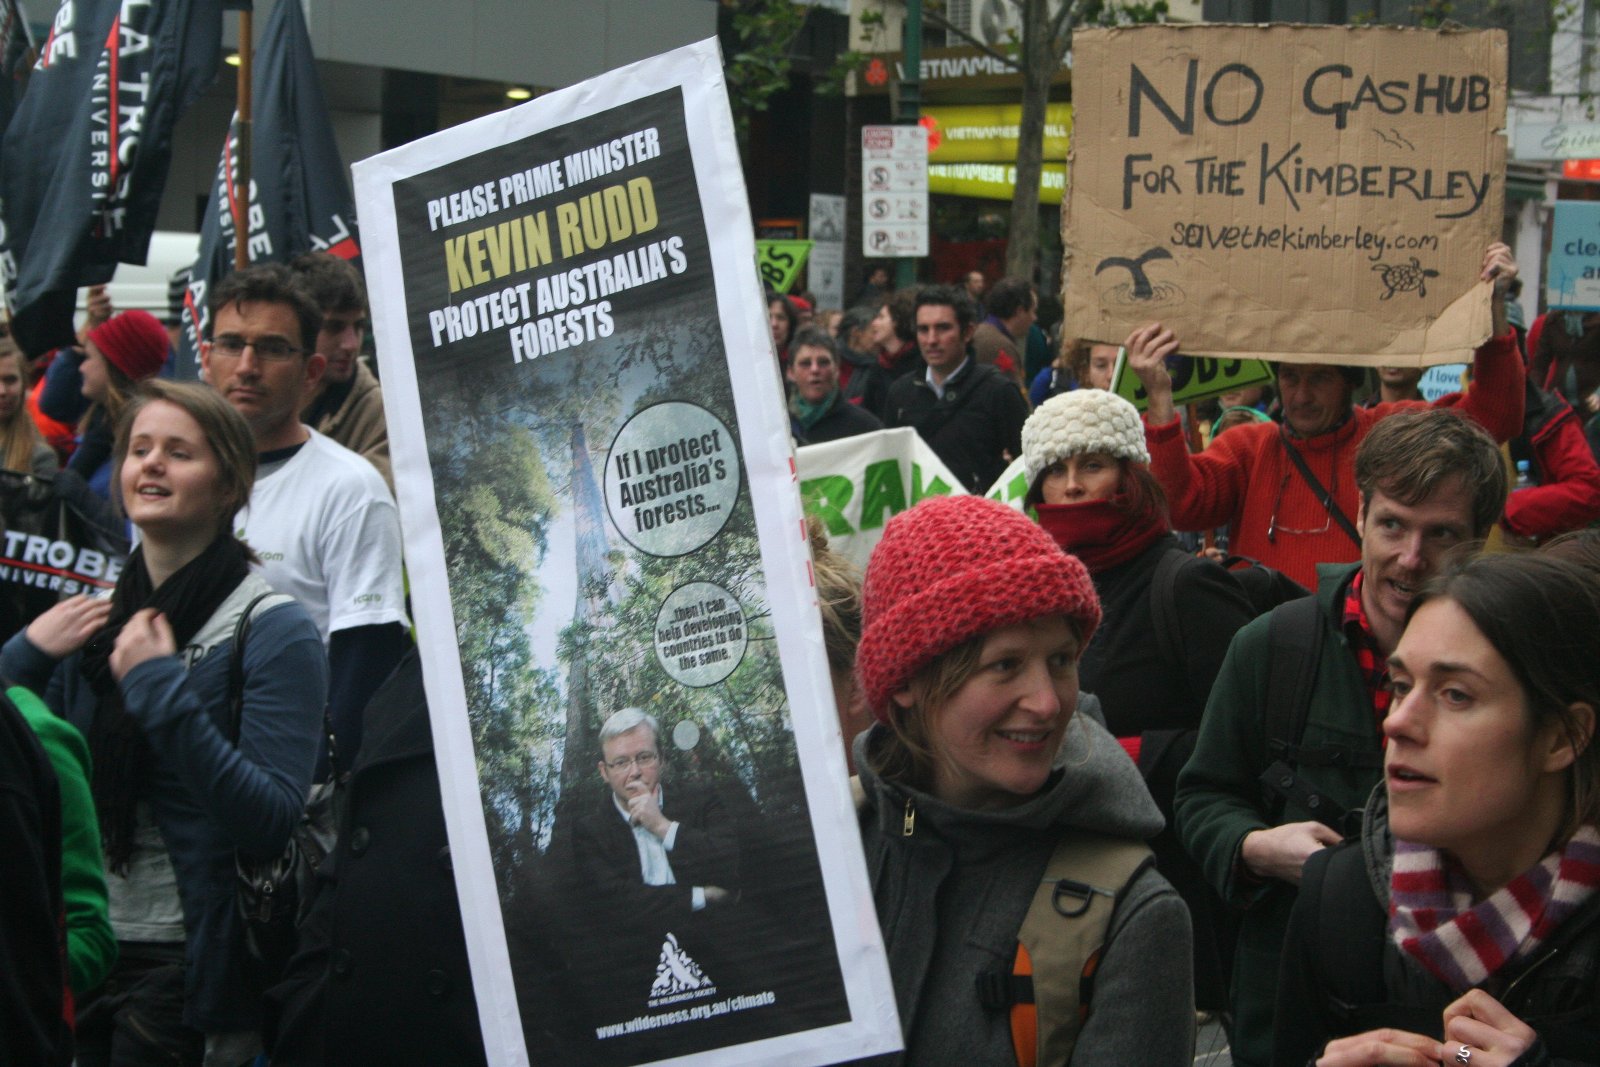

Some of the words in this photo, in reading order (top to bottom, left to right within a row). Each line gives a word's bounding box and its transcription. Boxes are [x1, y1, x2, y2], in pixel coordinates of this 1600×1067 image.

[896, 54, 1018, 80] VETNAMES
[1128, 59, 1264, 137] NO
[945, 125, 1019, 140] VIETNAMES
[427, 181, 499, 231] PLEASE
[500, 160, 565, 209] PRIME
[564, 127, 661, 187] MINISTER
[1123, 153, 1181, 210] FOR
[1185, 156, 1246, 196] THE
[444, 210, 552, 293] KEVIN
[556, 176, 658, 258] RUDD
[1171, 222, 1438, 261] savethekimberley.com
[429, 282, 531, 347] PROTECT
[536, 236, 687, 315] AUSTRALIA'S
[509, 300, 614, 364] FORESTS
[616, 453, 631, 480] If
[633, 449, 643, 475] I
[646, 429, 722, 473] protect
[620, 458, 726, 508] Australia's
[634, 494, 720, 532] forests...
[658, 625, 682, 643] help
[683, 610, 742, 637] developing
[706, 598, 726, 614] can
[663, 635, 715, 659] countries
[715, 630, 727, 645] to
[729, 627, 742, 642] do
[679, 655, 697, 671] the
[699, 648, 731, 666] same.
[596, 990, 775, 1040] www.wilderness.org.au/climate
